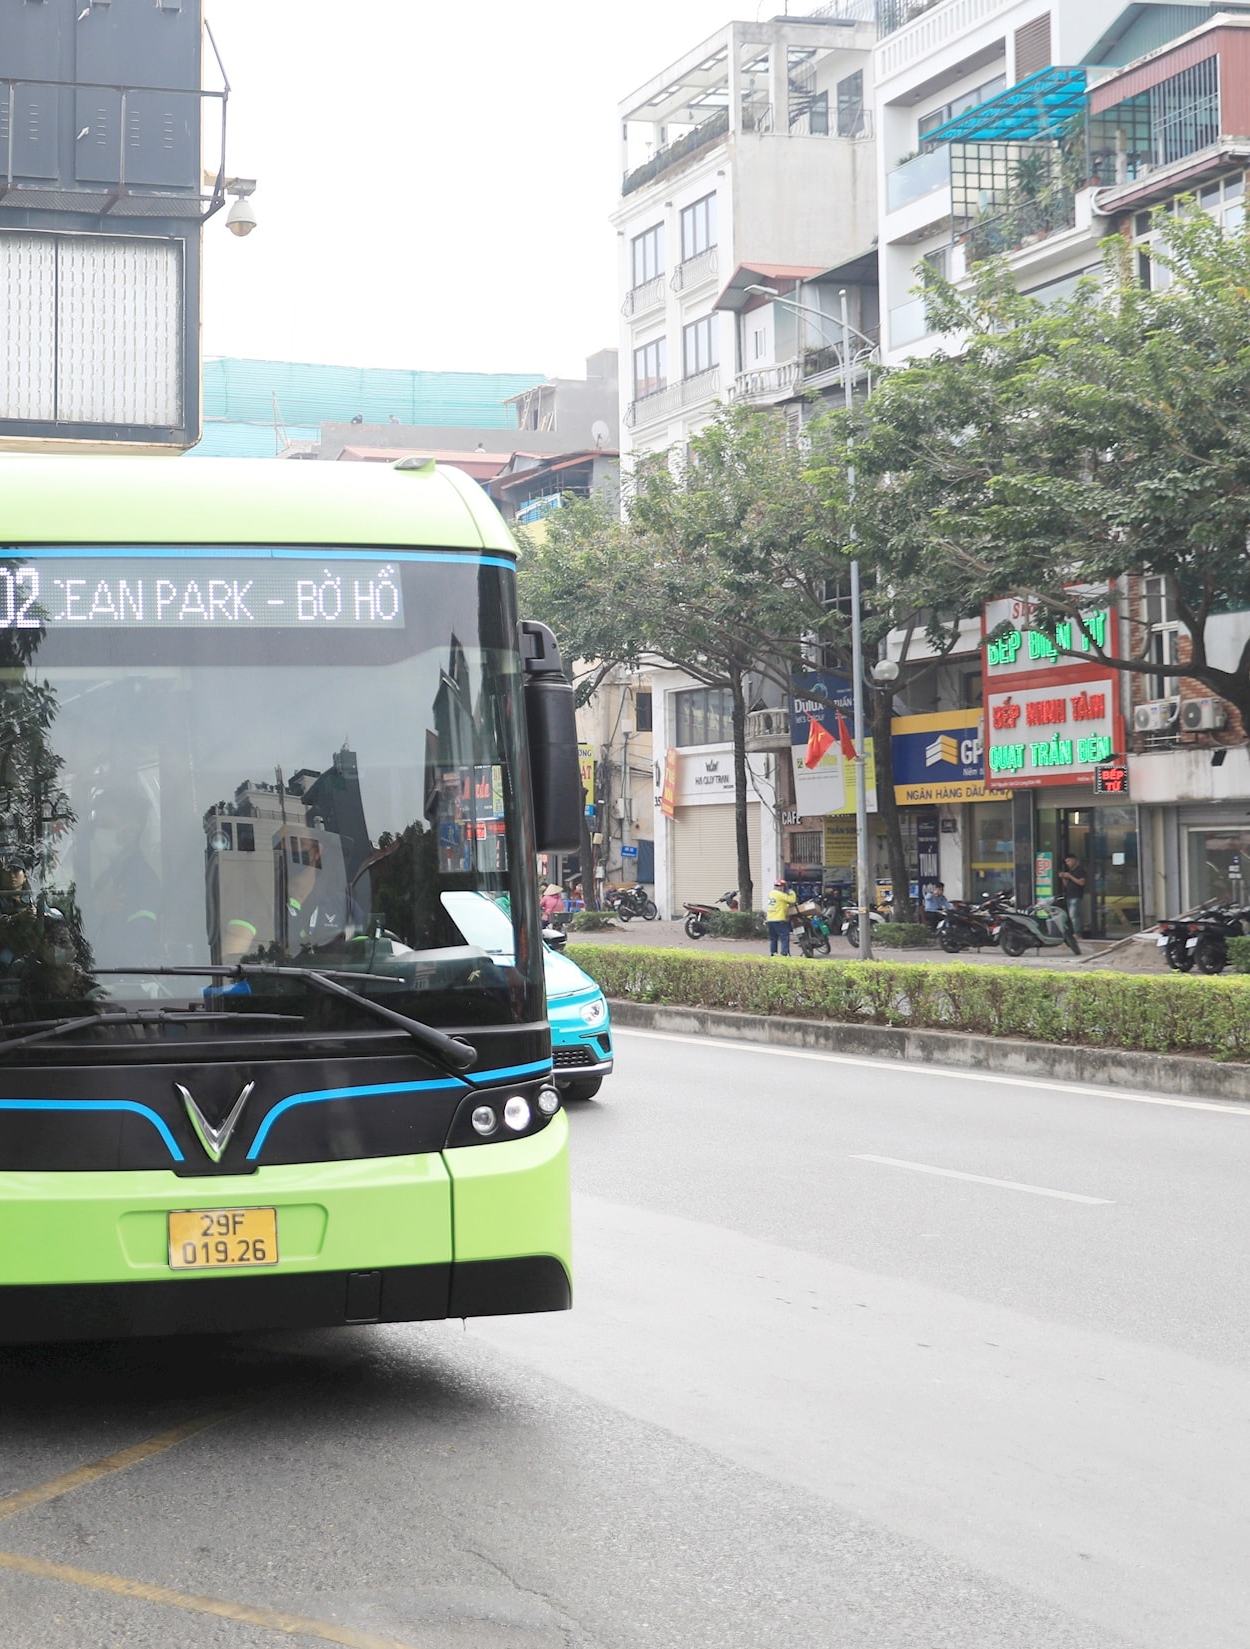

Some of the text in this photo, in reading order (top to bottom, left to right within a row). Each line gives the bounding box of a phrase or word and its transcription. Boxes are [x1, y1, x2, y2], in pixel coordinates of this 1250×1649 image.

[155, 579, 255, 621] PARK
[353, 564, 399, 621] HỒ
[794, 698, 825, 714] Dulux
[992, 696, 1021, 730] BẾP
[1070, 691, 1106, 721] TÂM
[989, 743, 1026, 773] QUẠT
[1030, 732, 1073, 767] TRẦN
[1102, 768, 1124, 780] BẾP
[906, 786, 933, 801] NGÂN
[935, 783, 963, 799] HÀNG
[200, 1213, 245, 1237] 29F
[182, 1239, 266, 1264] 019.26
